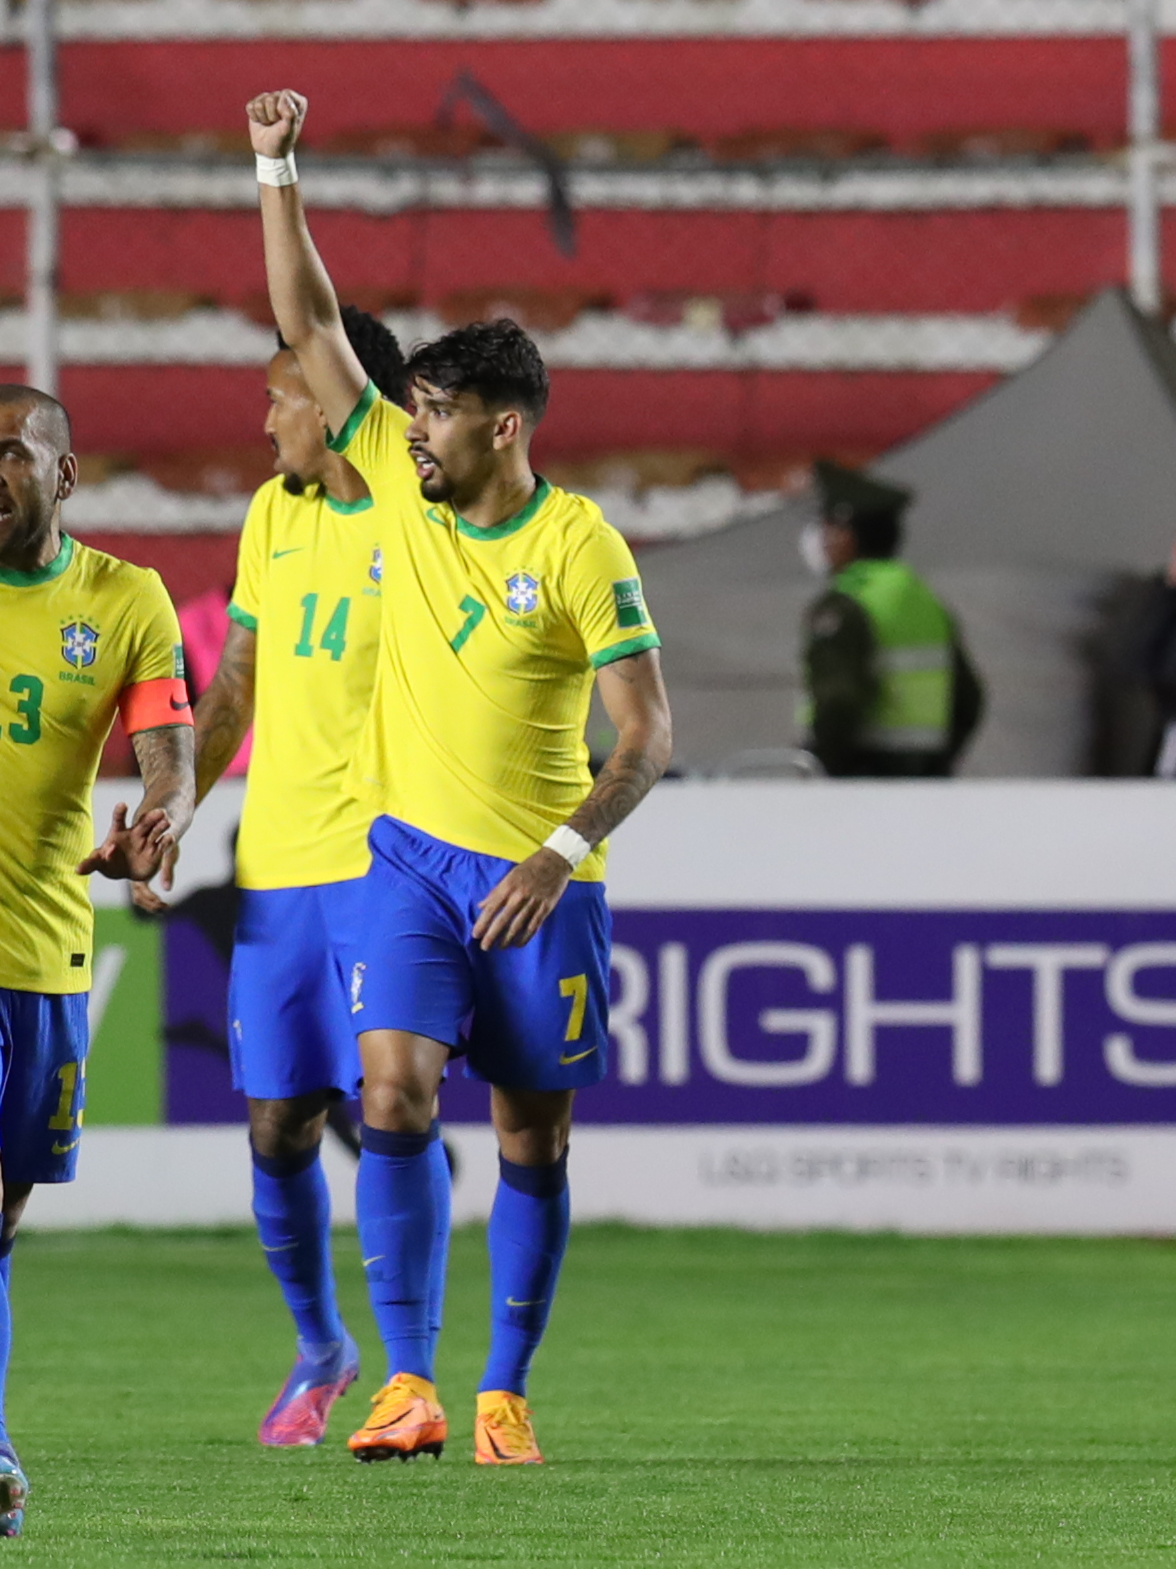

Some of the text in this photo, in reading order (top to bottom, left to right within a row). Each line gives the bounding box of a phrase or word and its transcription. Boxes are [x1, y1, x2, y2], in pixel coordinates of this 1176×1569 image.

[295, 593, 350, 661] 14
[450, 594, 485, 654] 7
[59, 671, 95, 685] BRASIL
[560, 973, 587, 1041] 7
[48, 1056, 85, 1130] 1
